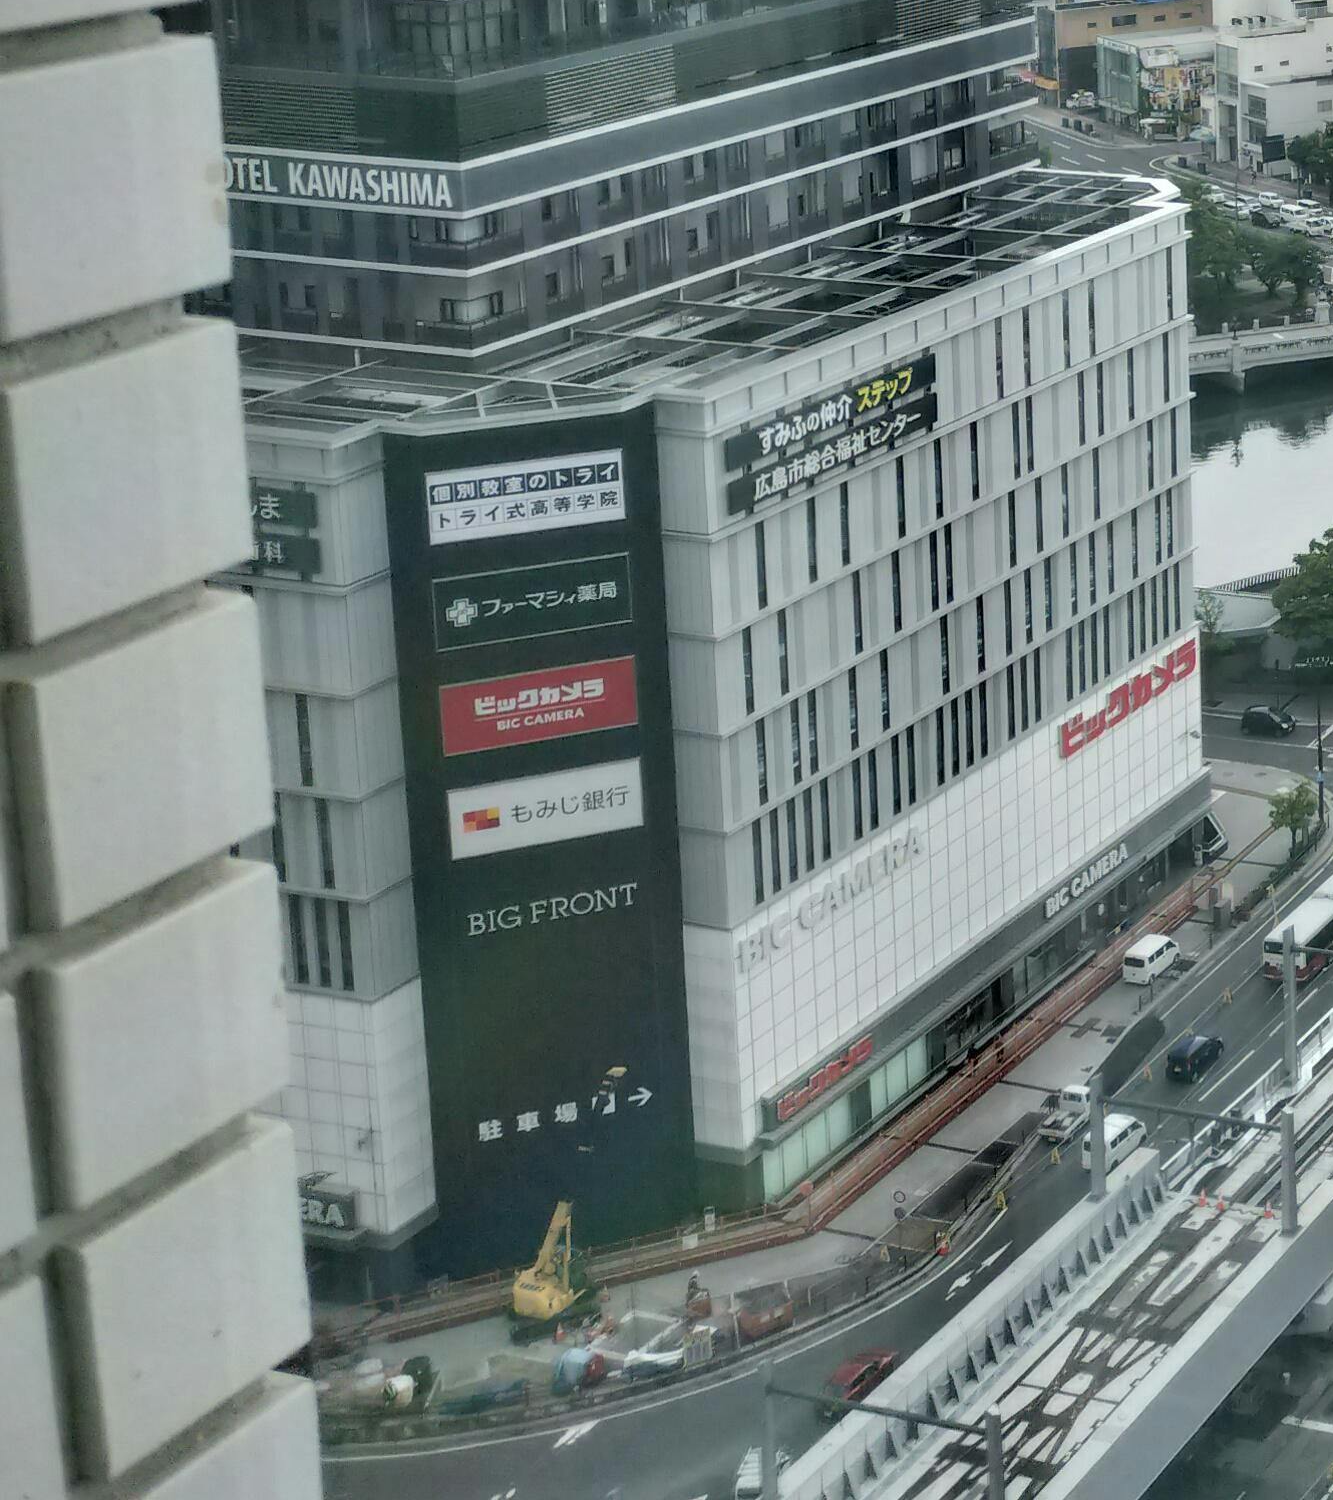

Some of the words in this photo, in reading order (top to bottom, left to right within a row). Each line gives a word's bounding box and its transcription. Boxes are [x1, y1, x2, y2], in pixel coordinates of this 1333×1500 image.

[223, 156, 278, 194] OTEL
[287, 161, 454, 209] KAWASHIMA
[758, 394, 853, 455] すみふの仲介
[856, 366, 913, 413] ステップ
[431, 463, 616, 504] 個別教室のトライ
[754, 412, 922, 502] 広島市総合福祉センター
[438, 490, 618, 529] トライ式高等学院
[481, 581, 617, 617] ファーマシィ薬局
[474, 678, 605, 717] ビックカメラ
[496, 717, 521, 731] BIC
[524, 707, 585, 726] CAMERA
[1059, 638, 1198, 759] ビックカメラ
[511, 785, 631, 824] もみじ銀行
[736, 911, 792, 974] BIC
[798, 826, 921, 930] CAMERA
[1045, 895, 1070, 920] BIC
[1070, 842, 1130, 900] CAMERA
[467, 904, 522, 937] BIG
[529, 882, 638, 925] FRONT
[777, 1032, 873, 1122] ビックカメラ
[300, 1198, 345, 1228] ERA
